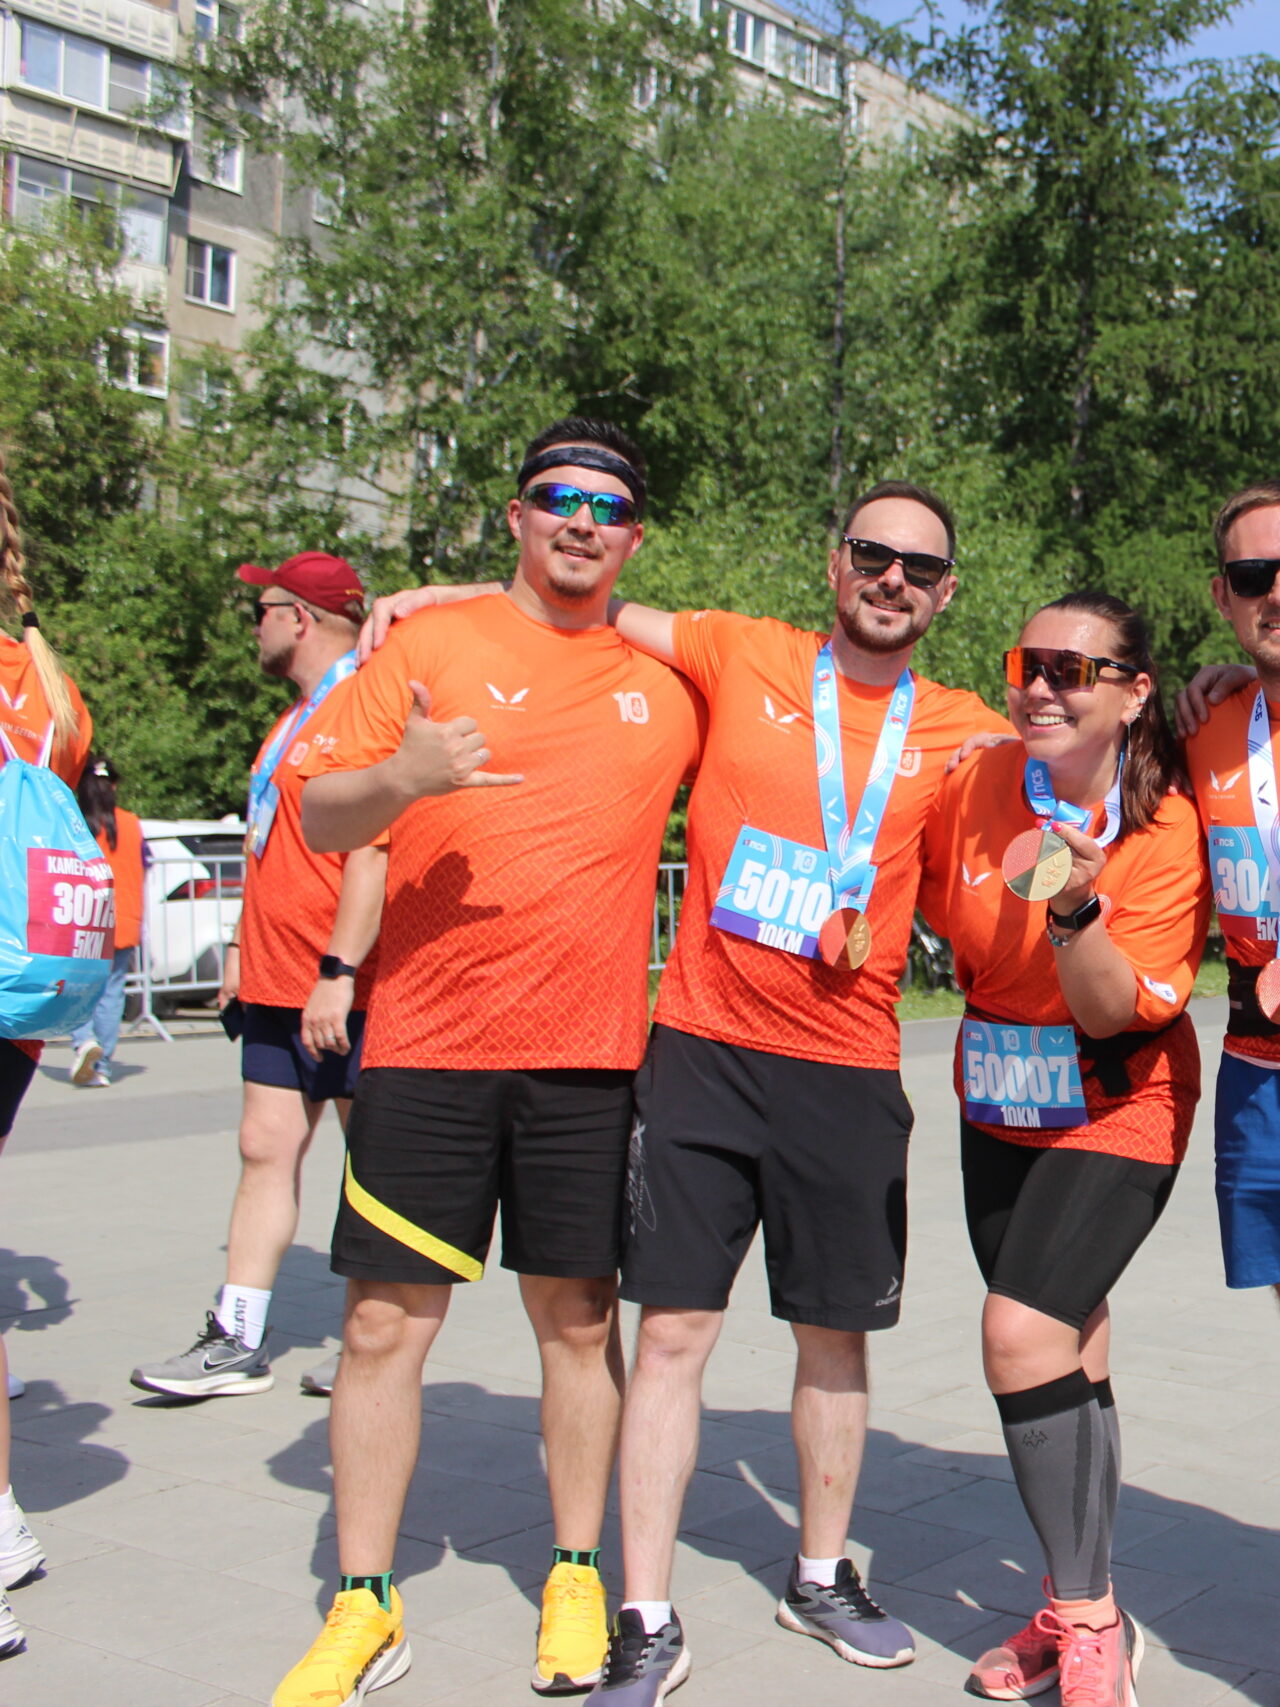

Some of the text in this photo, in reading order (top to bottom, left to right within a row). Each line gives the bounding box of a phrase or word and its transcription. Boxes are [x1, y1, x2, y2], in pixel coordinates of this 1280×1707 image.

[612, 691, 650, 724] 10
[1031, 769, 1047, 793] ПСБ
[792, 849, 817, 874] 10
[733, 859, 832, 932] 5010
[1256, 917, 1278, 941] 5K
[1001, 1030, 1020, 1051] 10
[967, 1050, 1071, 1103] 50007
